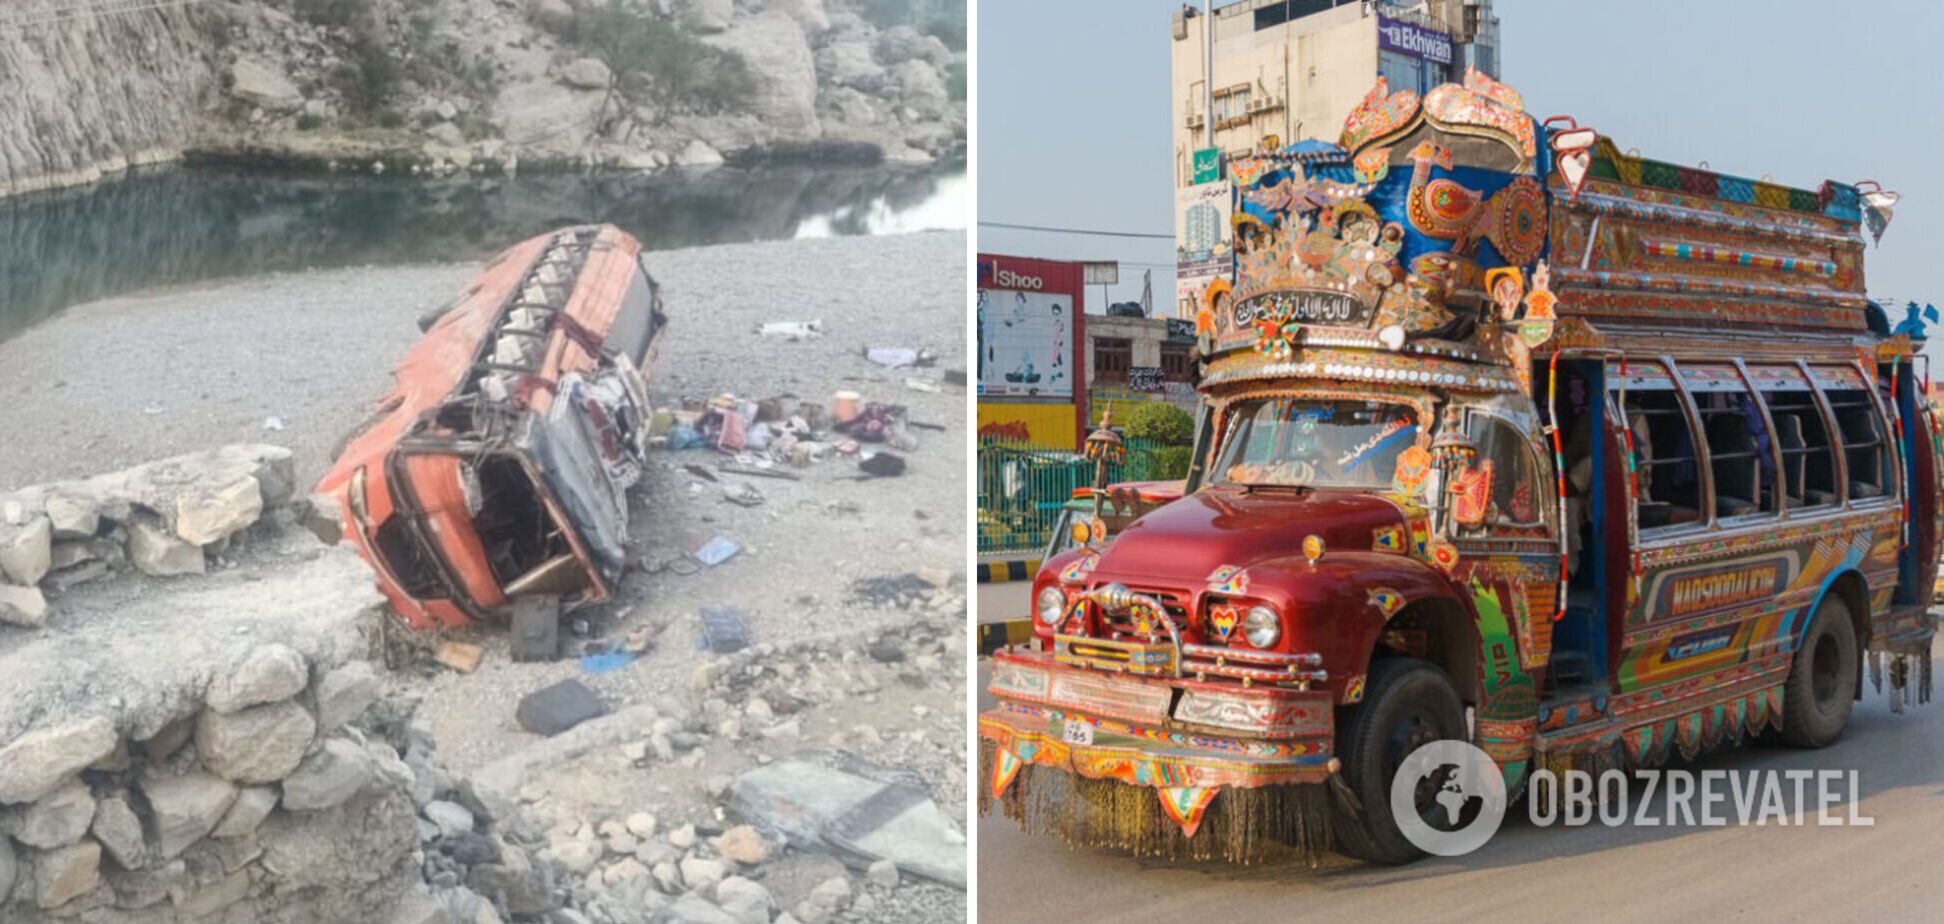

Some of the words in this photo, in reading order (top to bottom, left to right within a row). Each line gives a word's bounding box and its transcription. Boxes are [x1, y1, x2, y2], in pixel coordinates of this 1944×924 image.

[1401, 26, 1452, 60] Ekhwan
[999, 270, 1043, 289] Shoo
[1490, 643, 1511, 686] VIP
